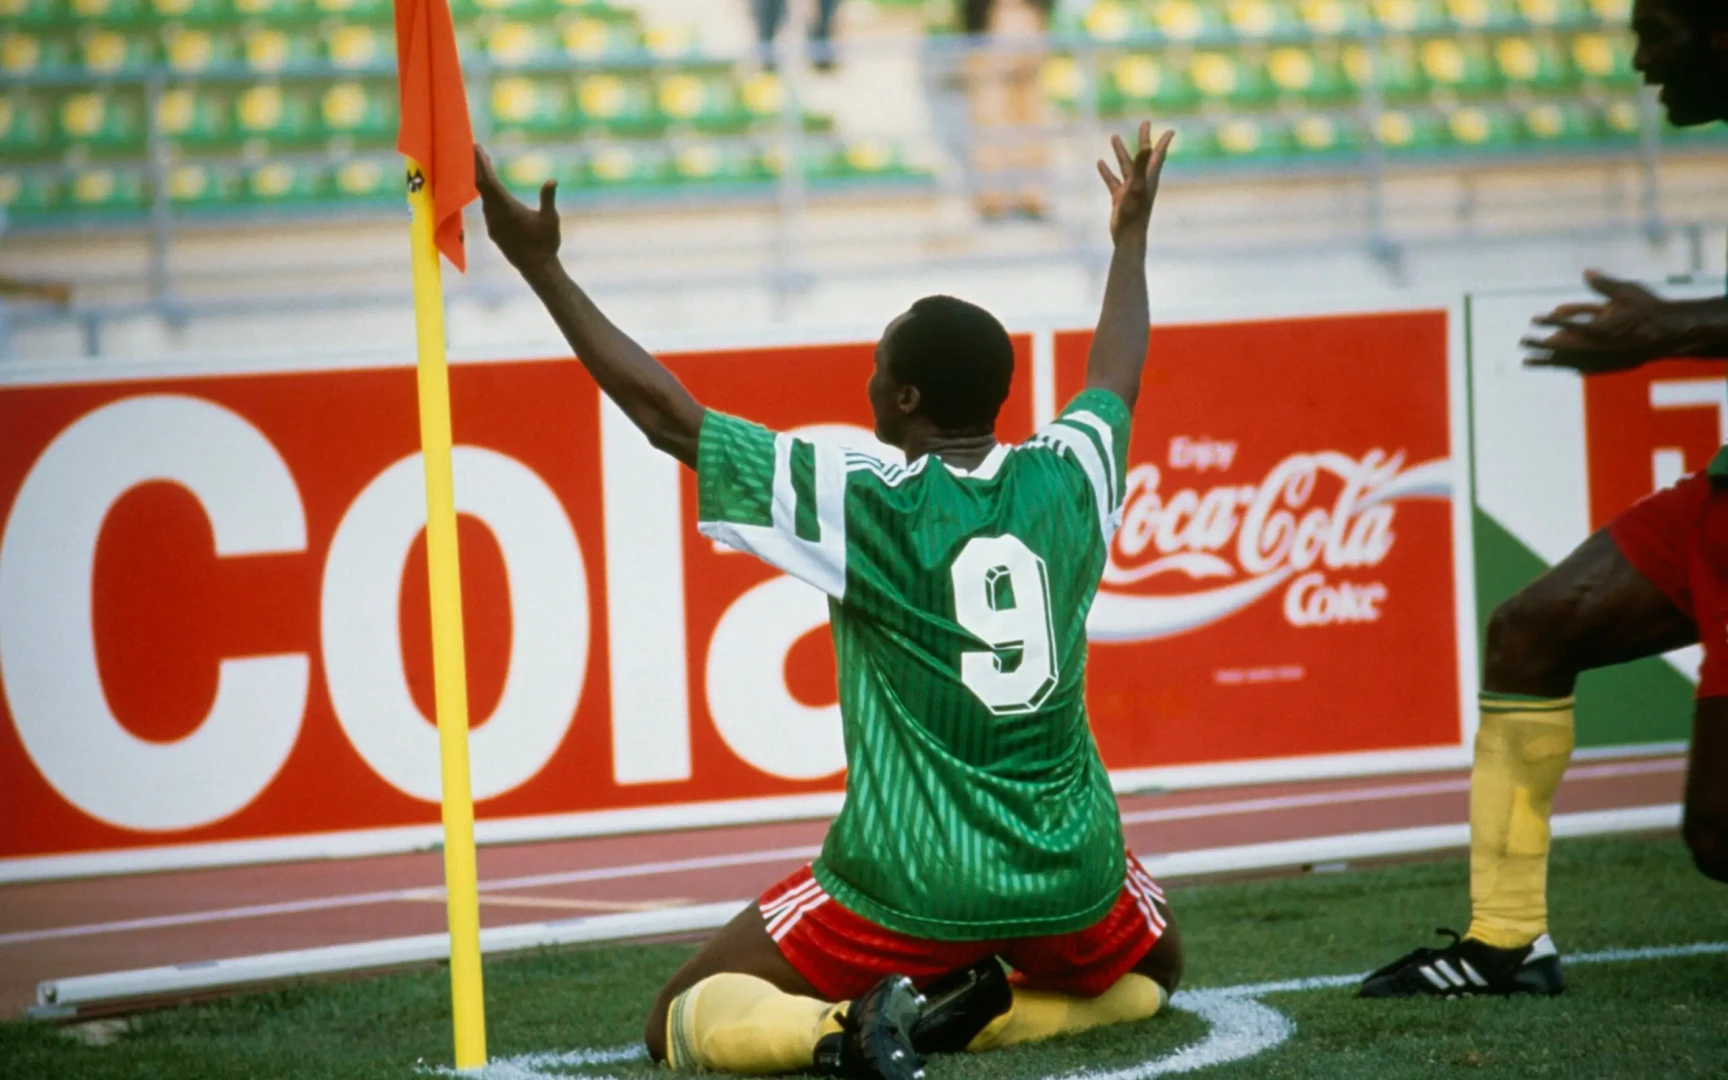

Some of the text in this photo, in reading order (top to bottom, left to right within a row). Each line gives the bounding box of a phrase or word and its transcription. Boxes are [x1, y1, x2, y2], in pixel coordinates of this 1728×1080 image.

[1168, 435, 1237, 472] Enjoy
[951, 534, 1058, 715] 9
[1284, 572, 1387, 627] Coke
